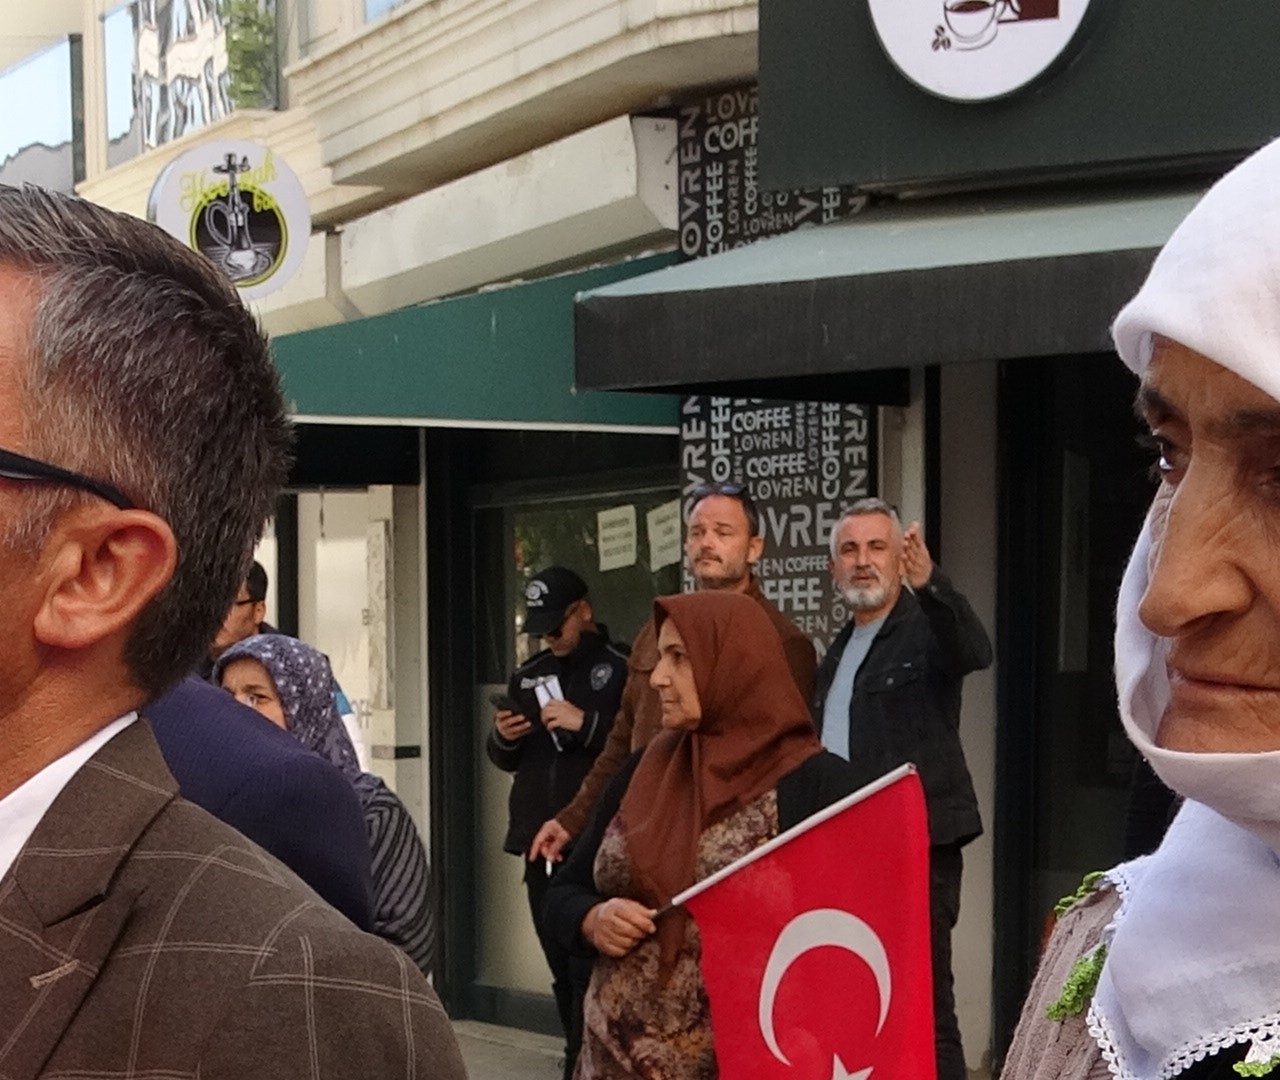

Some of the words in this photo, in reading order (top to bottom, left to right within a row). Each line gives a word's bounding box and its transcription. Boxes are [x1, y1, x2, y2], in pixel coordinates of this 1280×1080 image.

[731, 406, 793, 433] COFFEE
[734, 430, 793, 453] LOVREN
[746, 452, 808, 479] COFFEE
[748, 475, 819, 501] LOVREN
